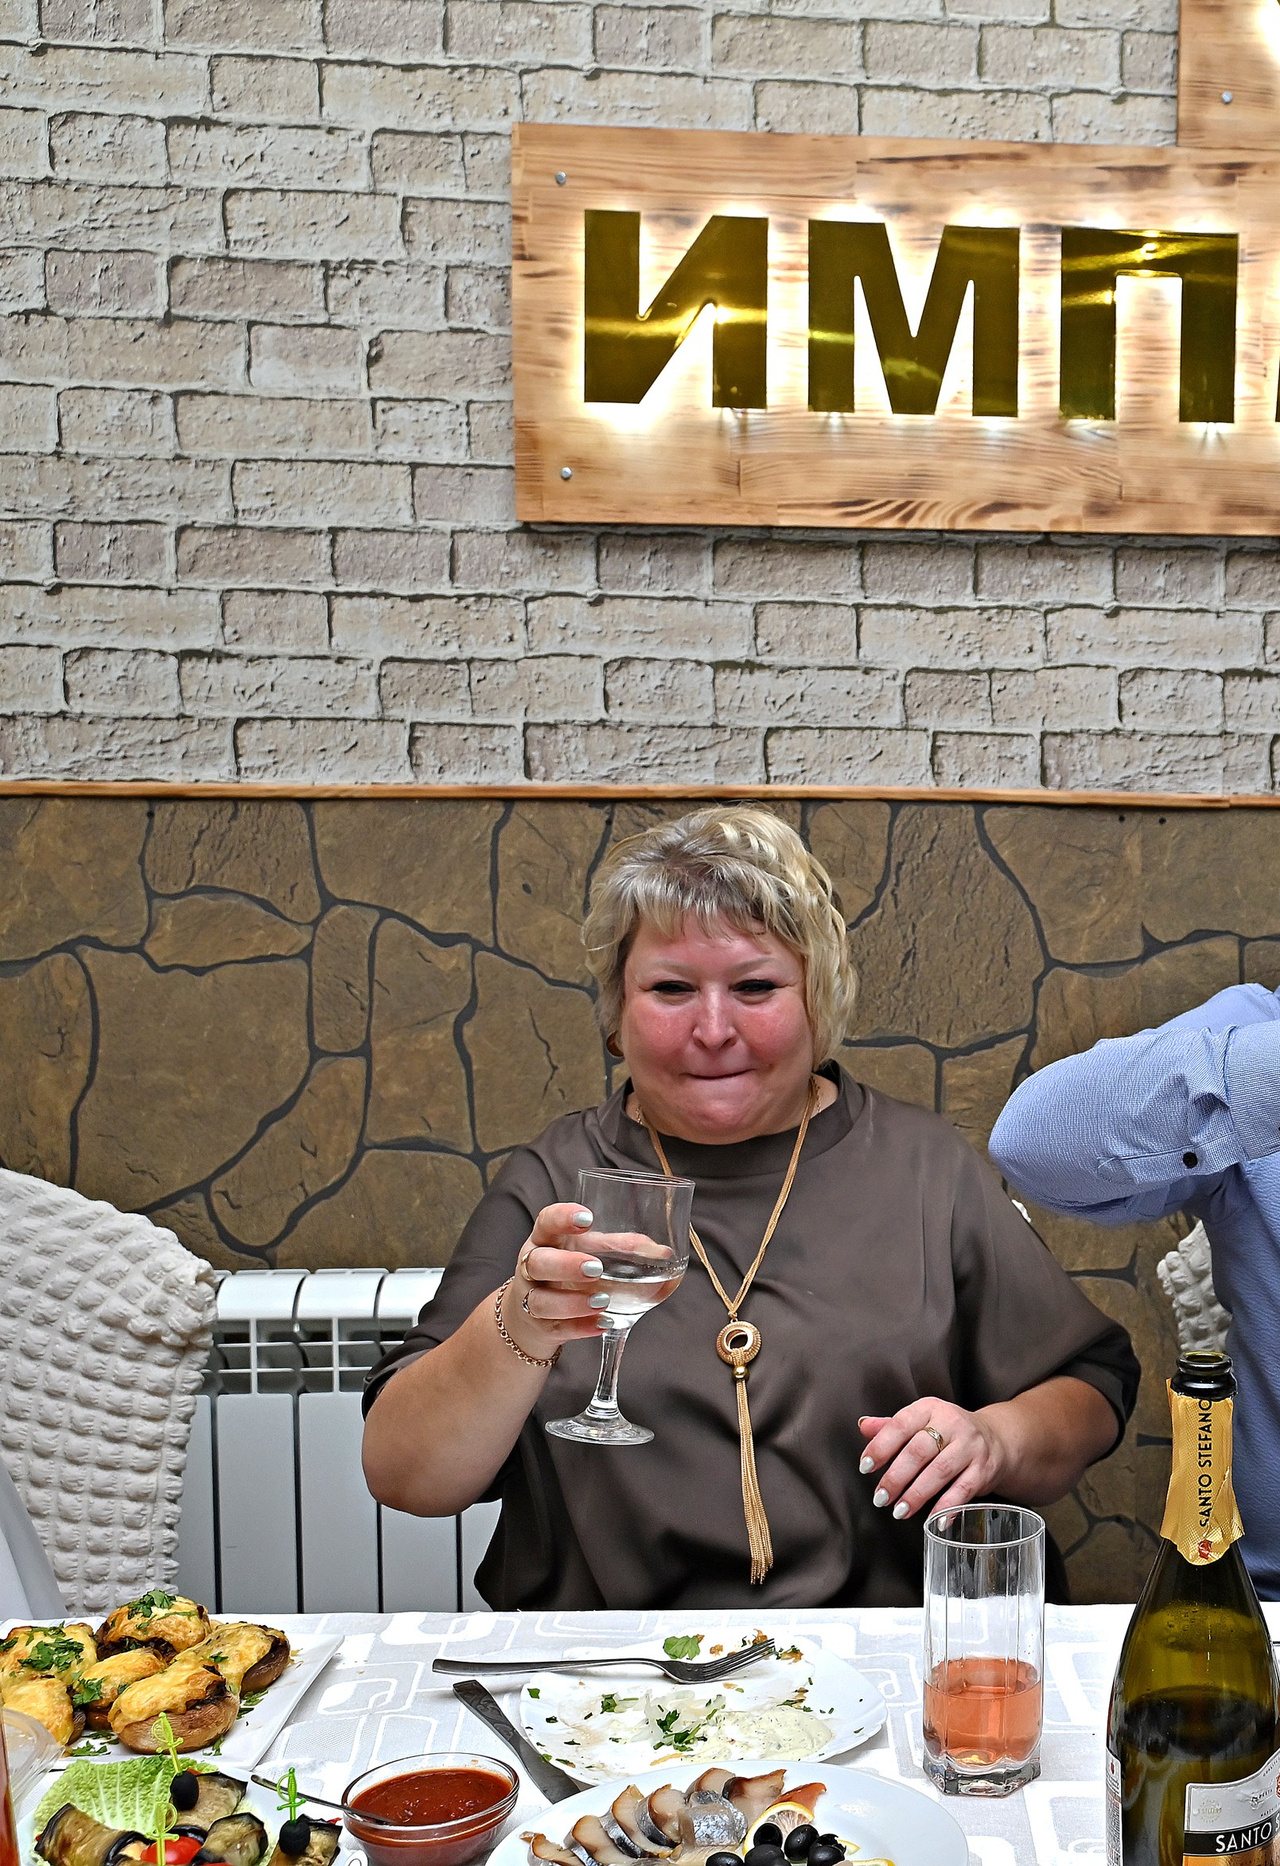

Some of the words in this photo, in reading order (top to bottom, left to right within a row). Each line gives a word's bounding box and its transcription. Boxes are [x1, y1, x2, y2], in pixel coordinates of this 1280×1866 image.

[1198, 1399, 1213, 1468] STEFANO
[1198, 1473, 1213, 1528] SANTO
[1215, 1821, 1272, 1853] SANTO
